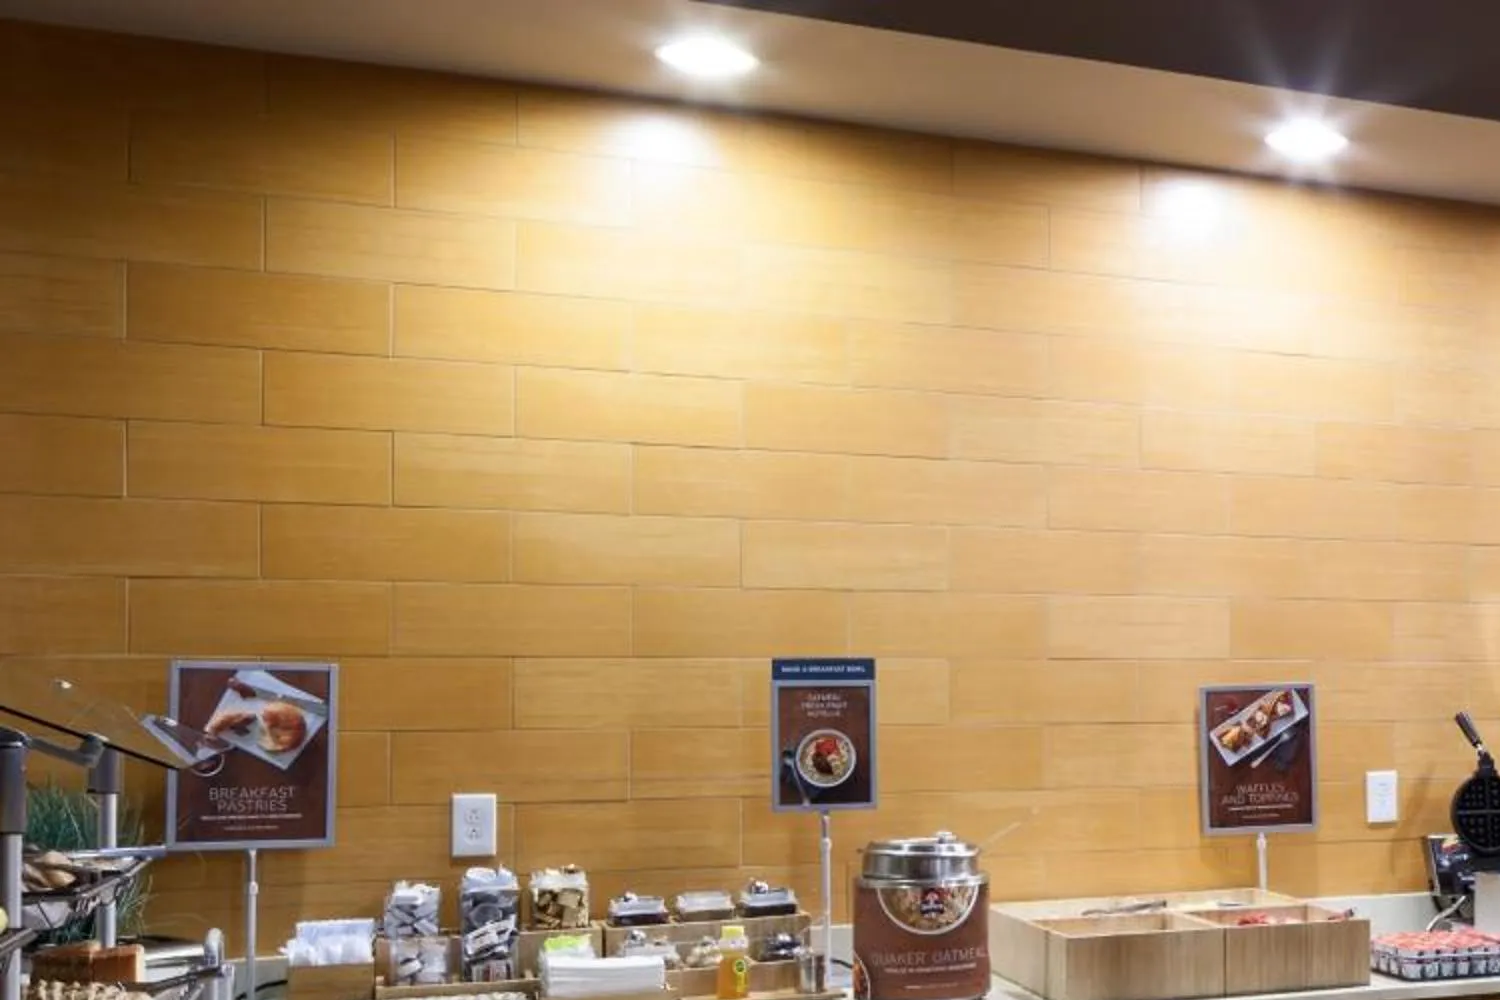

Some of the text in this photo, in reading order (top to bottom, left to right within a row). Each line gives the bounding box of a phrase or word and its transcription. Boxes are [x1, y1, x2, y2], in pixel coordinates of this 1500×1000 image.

[208, 785, 296, 801] BREAKFAST
[216, 799, 288, 813] PASTRIES
[870, 951, 926, 966] QUAKER
